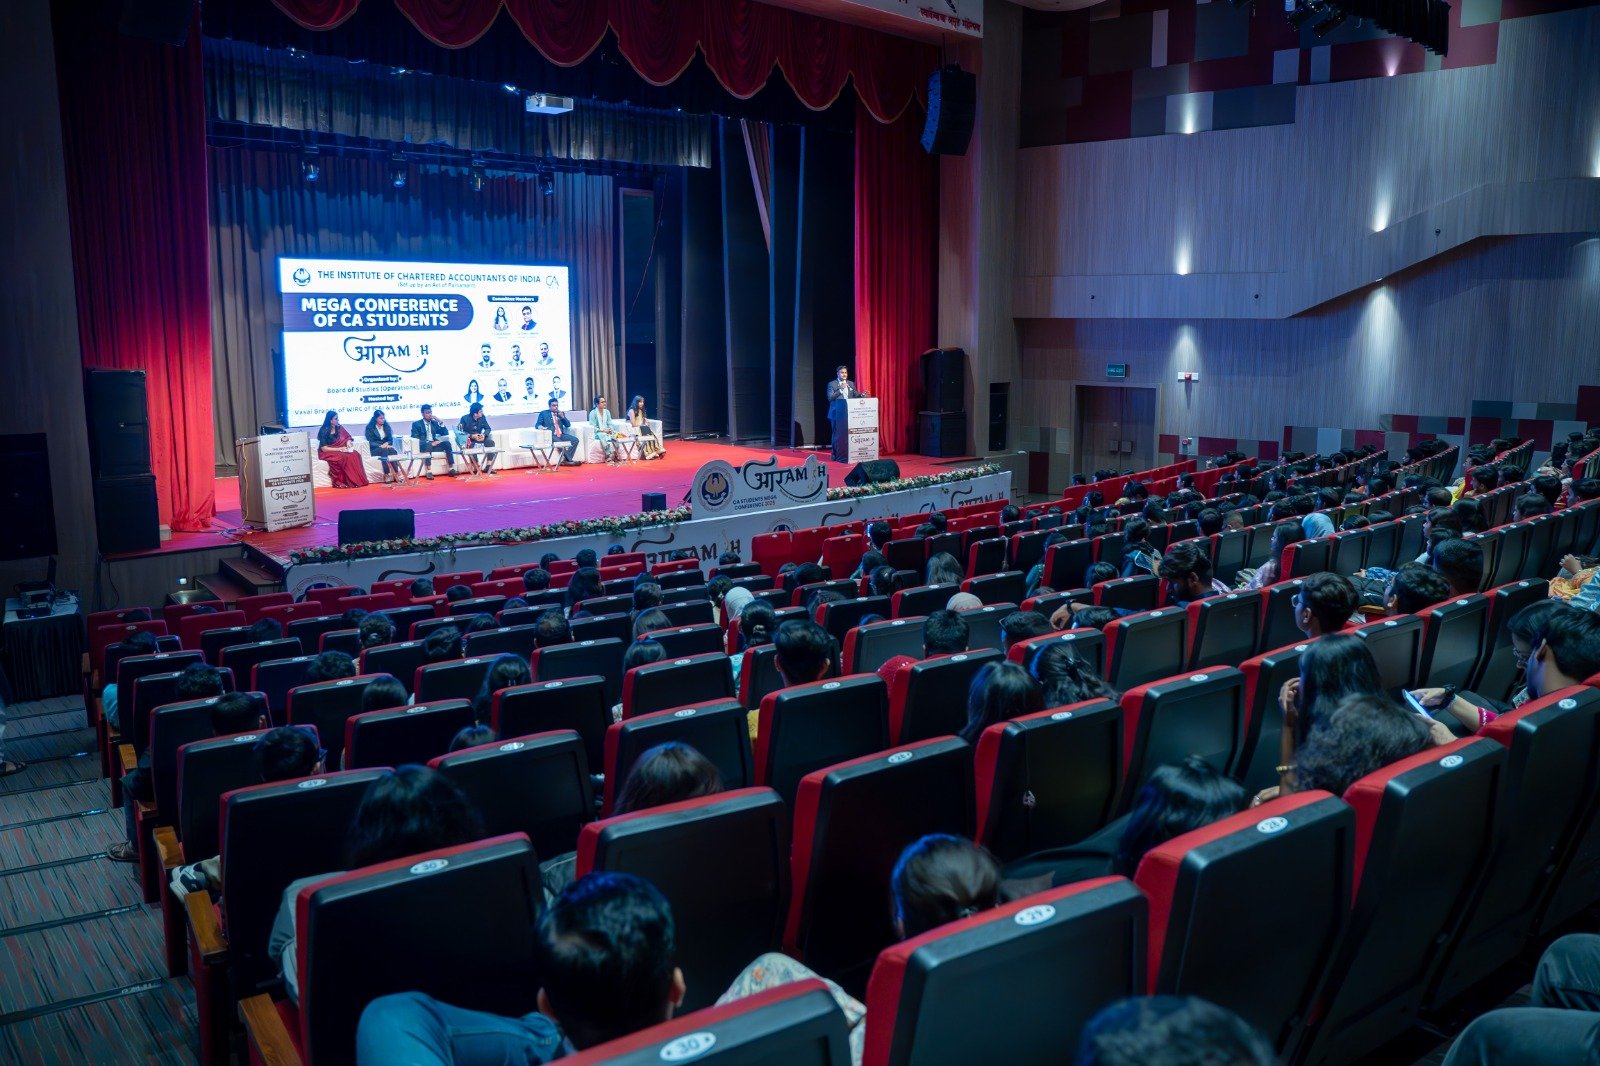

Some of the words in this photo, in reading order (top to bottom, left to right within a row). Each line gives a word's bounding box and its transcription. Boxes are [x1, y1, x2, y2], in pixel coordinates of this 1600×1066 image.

[318, 270, 335, 279] THE
[337, 270, 381, 280] INSTITUTE
[383, 271, 395, 280] OF
[397, 272, 446, 281] CHARTERED
[448, 273, 506, 282] ACCOUNTANTS
[508, 274, 519, 283] OF
[520, 275, 541, 283] INDIA
[301, 297, 352, 312] MEGA
[354, 298, 459, 312] CONFERENCE
[313, 313, 338, 327] OF
[340, 313, 364, 327] CA
[366, 313, 449, 327] STUDENTS
[740, 496, 763, 505] STUDENTS
[735, 502, 764, 511] CONFERENCE
[1267, 820, 1280, 830] 28
[422, 861, 437, 871] 30
[1029, 908, 1043, 919] 29
[680, 1038, 700, 1054] 30
